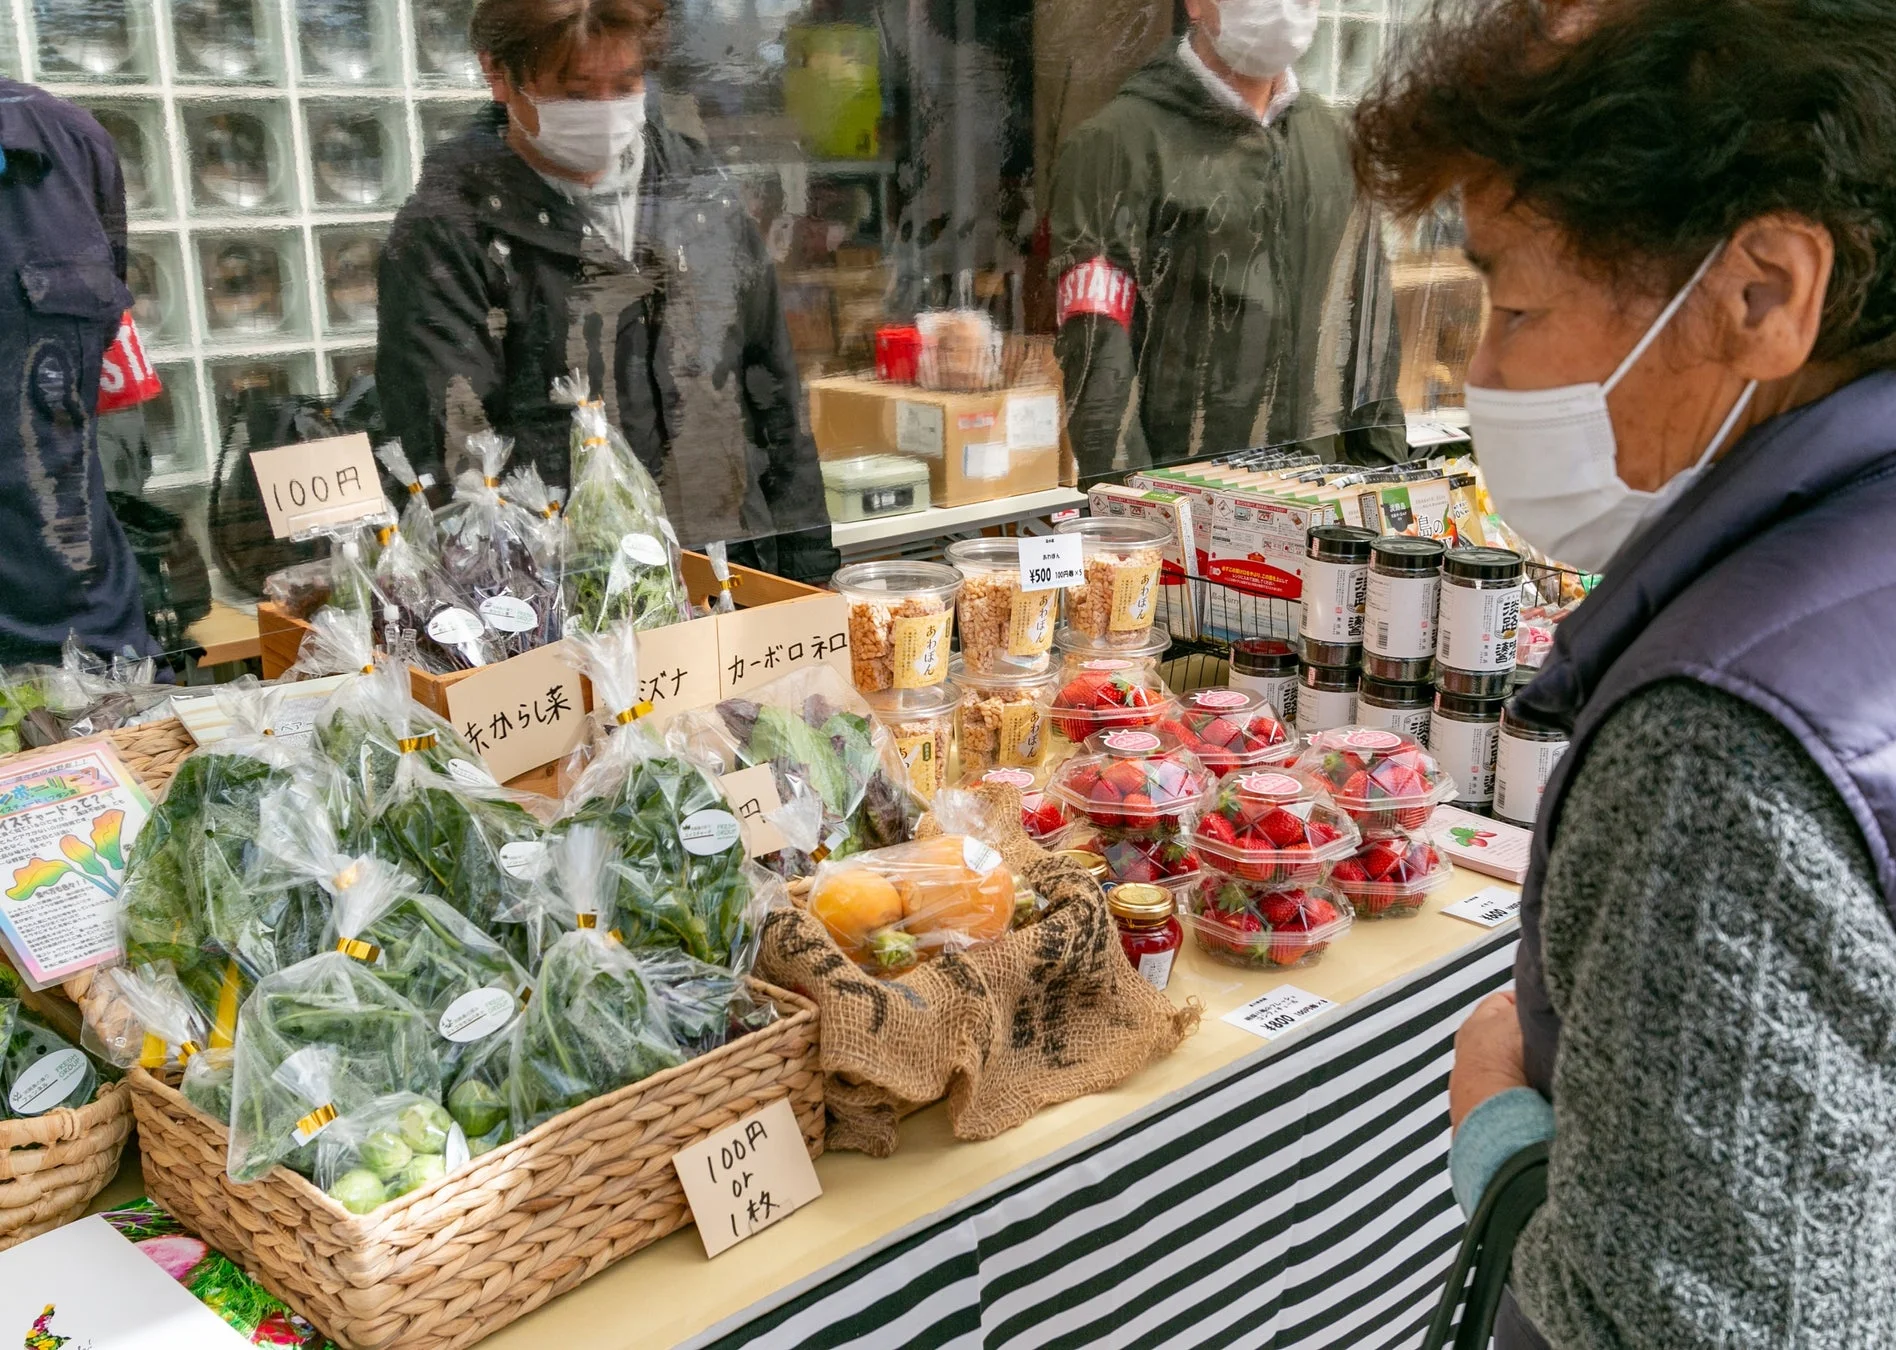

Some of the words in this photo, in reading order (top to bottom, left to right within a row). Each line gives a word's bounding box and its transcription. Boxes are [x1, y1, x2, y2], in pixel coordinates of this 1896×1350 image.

[1064, 264, 1135, 311] STAFF
[272, 465, 362, 512] 100円
[1029, 567, 1051, 583] ¥500
[464, 685, 571, 756] 赤からし菜
[707, 1120, 768, 1184] 100円
[732, 1171, 754, 1198] or
[731, 1190, 780, 1237] 1枚
